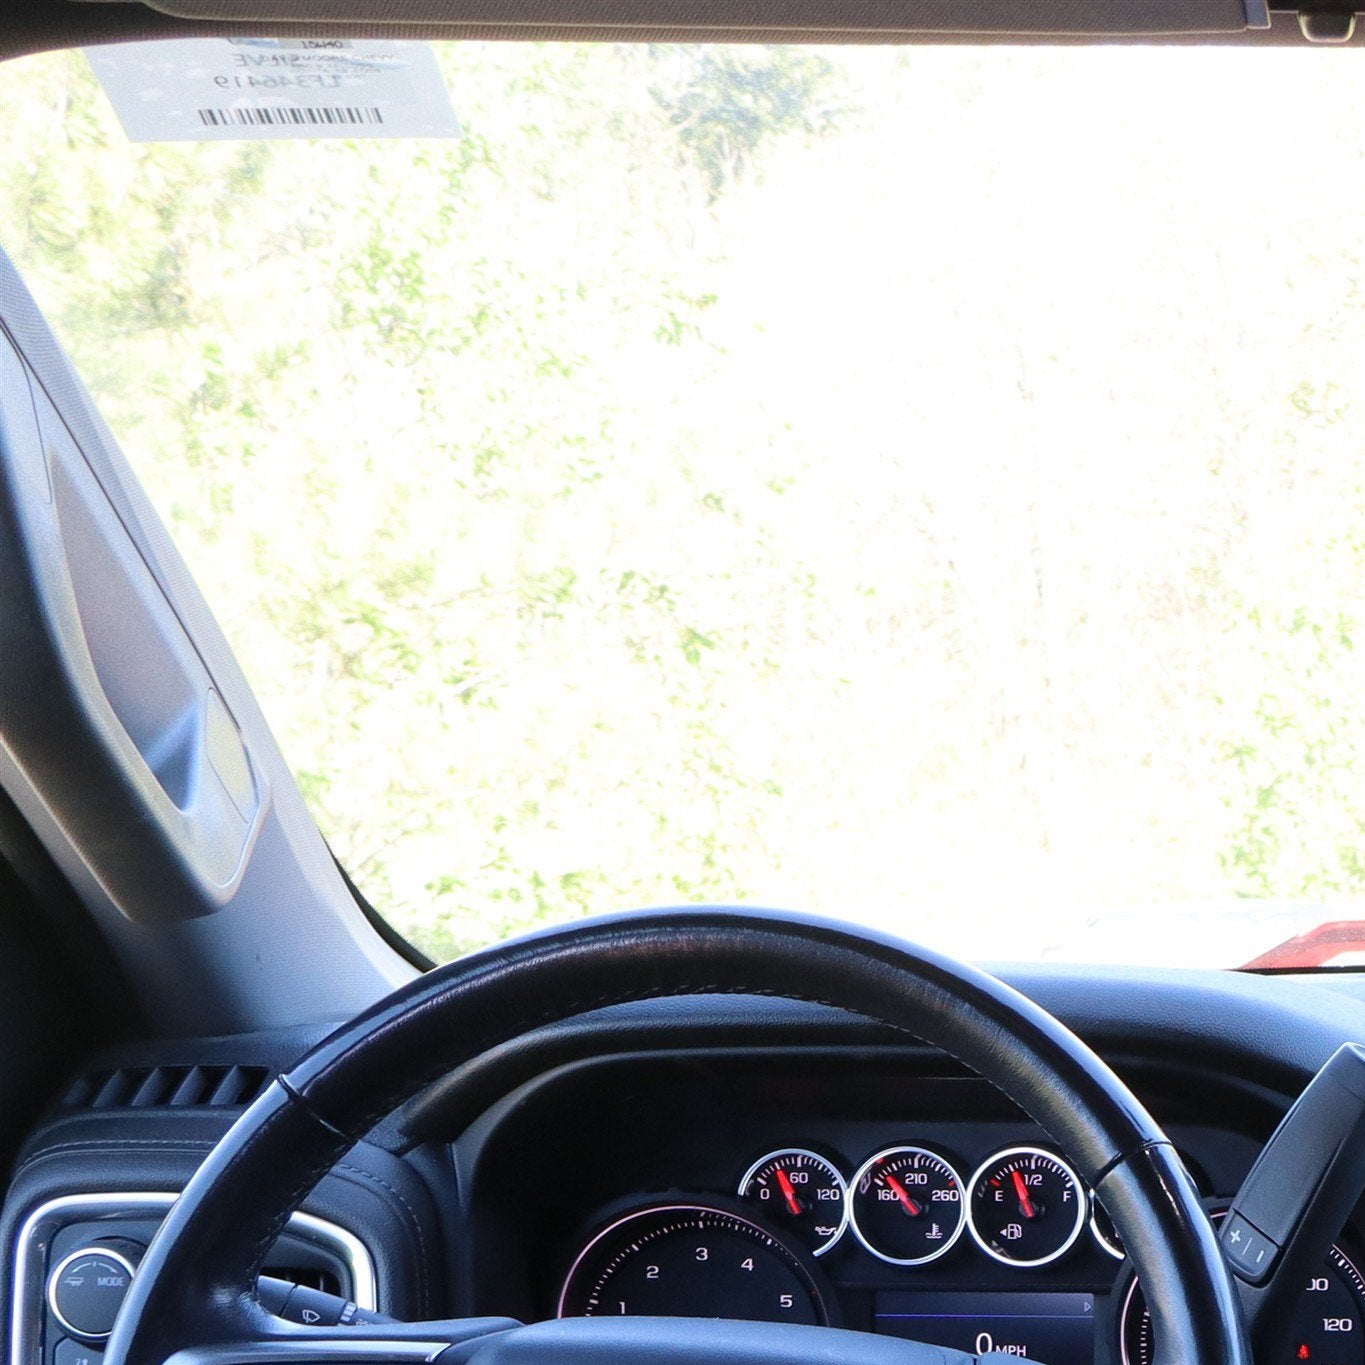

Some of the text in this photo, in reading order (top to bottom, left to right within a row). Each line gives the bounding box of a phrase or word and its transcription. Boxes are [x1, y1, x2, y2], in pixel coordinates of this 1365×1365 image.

[788, 1172, 809, 1184] 60
[905, 1172, 928, 1185] 210
[1024, 1173, 1043, 1186] 1/2
[760, 1188, 770, 1200] 0
[816, 1188, 841, 1201] 120
[877, 1188, 902, 1201] 160
[931, 1189, 960, 1202] 260
[994, 1190, 1004, 1202] E
[1062, 1190, 1072, 1203] F
[695, 1247, 709, 1261] 3
[740, 1258, 754, 1272] 4
[646, 1265, 659, 1279] 2
[97, 1276, 125, 1288] MODE
[780, 1294, 793, 1308] 5
[619, 1301, 626, 1315] 1
[1322, 1318, 1353, 1332] 120
[974, 1332, 1028, 1359] 0 MPH
